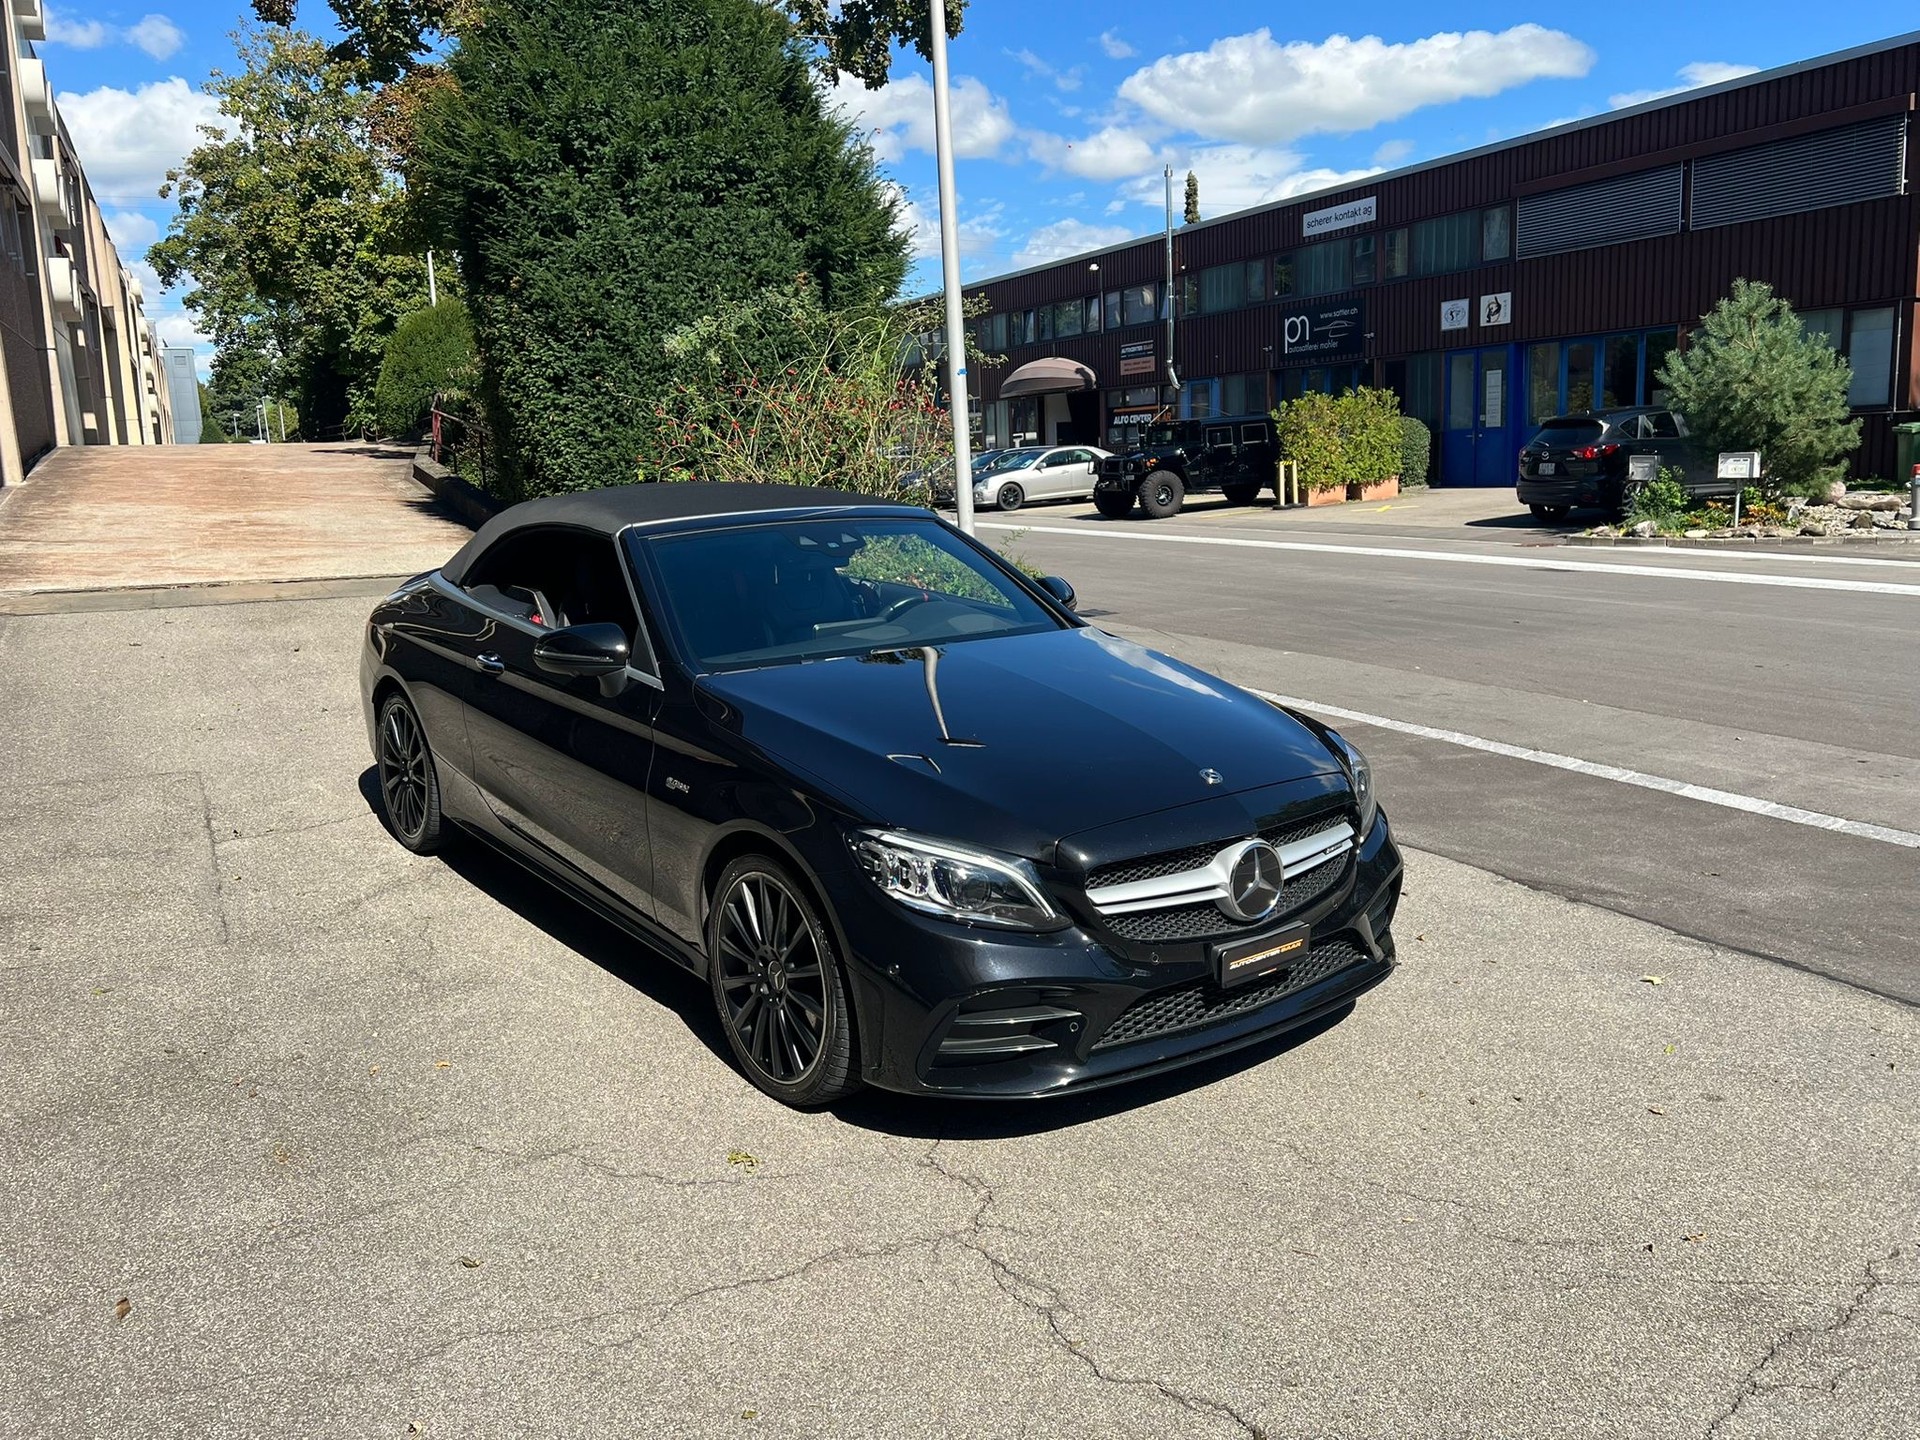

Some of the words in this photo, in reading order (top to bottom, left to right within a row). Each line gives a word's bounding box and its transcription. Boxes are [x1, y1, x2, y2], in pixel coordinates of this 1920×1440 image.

[1306, 215, 1332, 229] scherer
[1334, 206, 1361, 222] kontakt
[1362, 206, 1372, 216] ag
[1130, 413, 1152, 423] CENTER
[1229, 950, 1280, 970] AUTOCENTER
